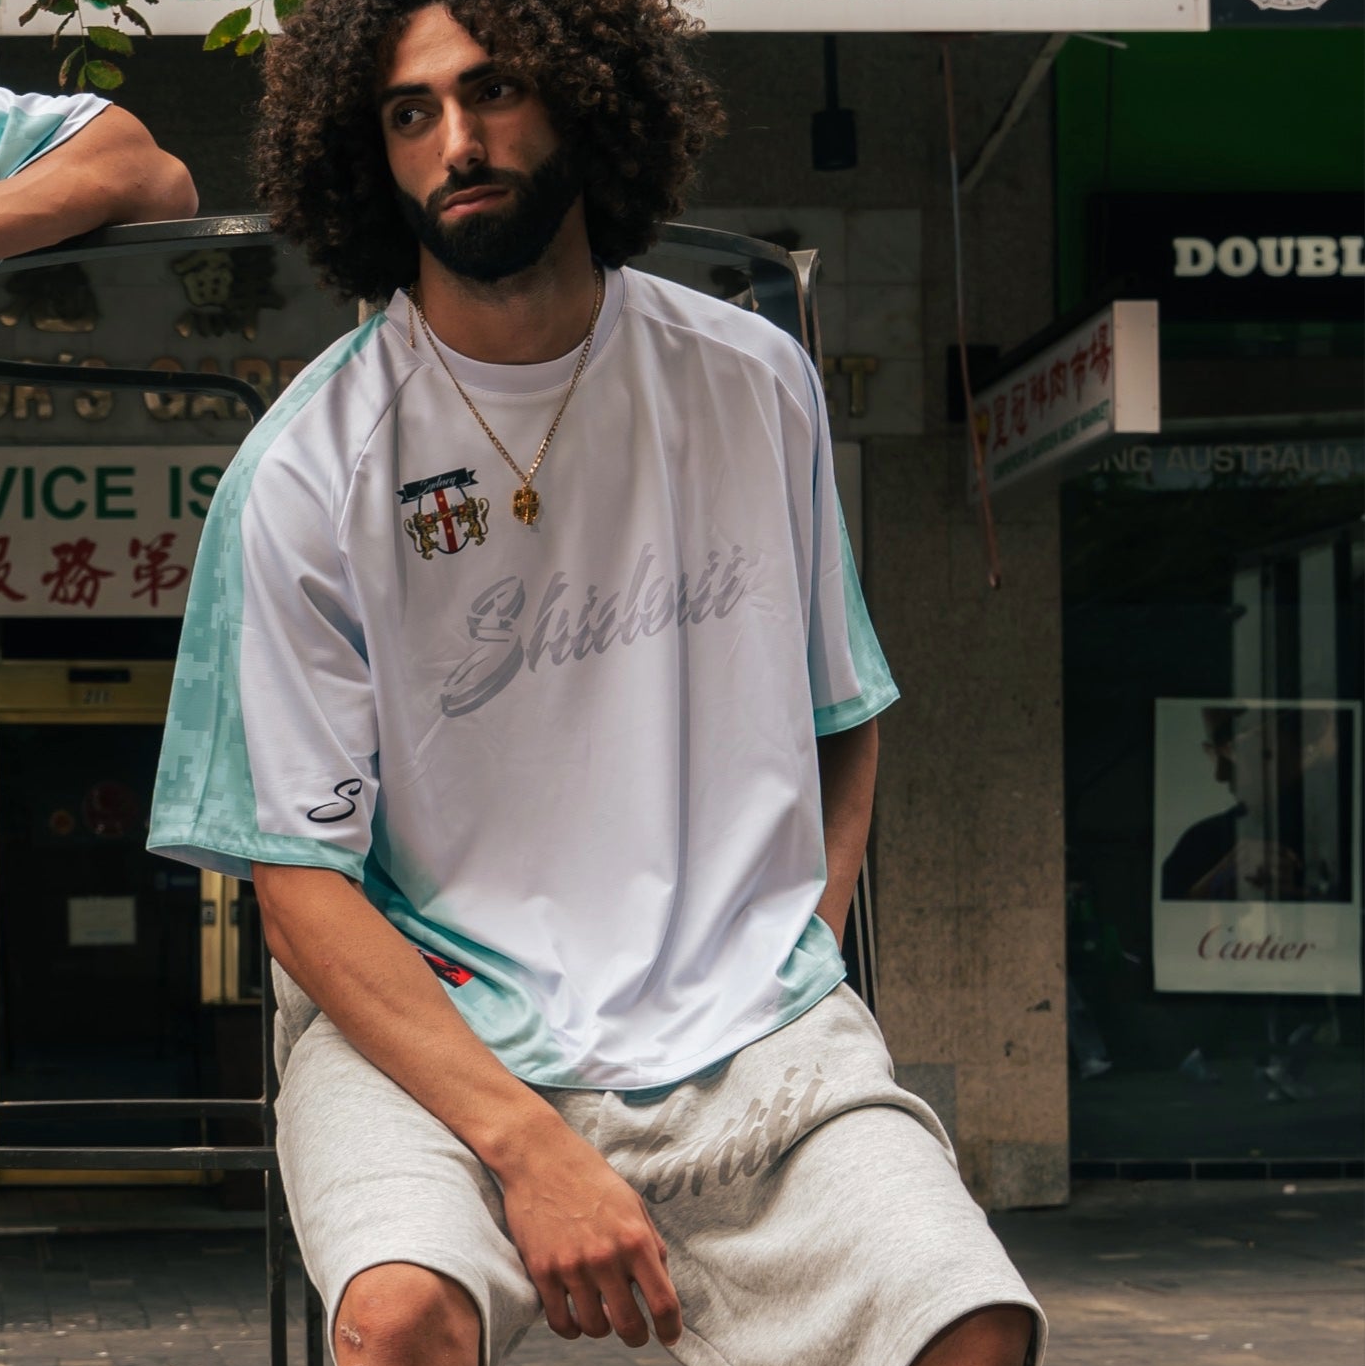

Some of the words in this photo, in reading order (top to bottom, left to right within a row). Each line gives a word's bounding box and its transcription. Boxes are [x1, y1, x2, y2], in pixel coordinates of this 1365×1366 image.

[1171, 235, 1365, 278] DOUBL
[1166, 443, 1352, 473] AUSTRALIA
[307, 778, 363, 823] S
[1196, 922, 1317, 963] Cartier
